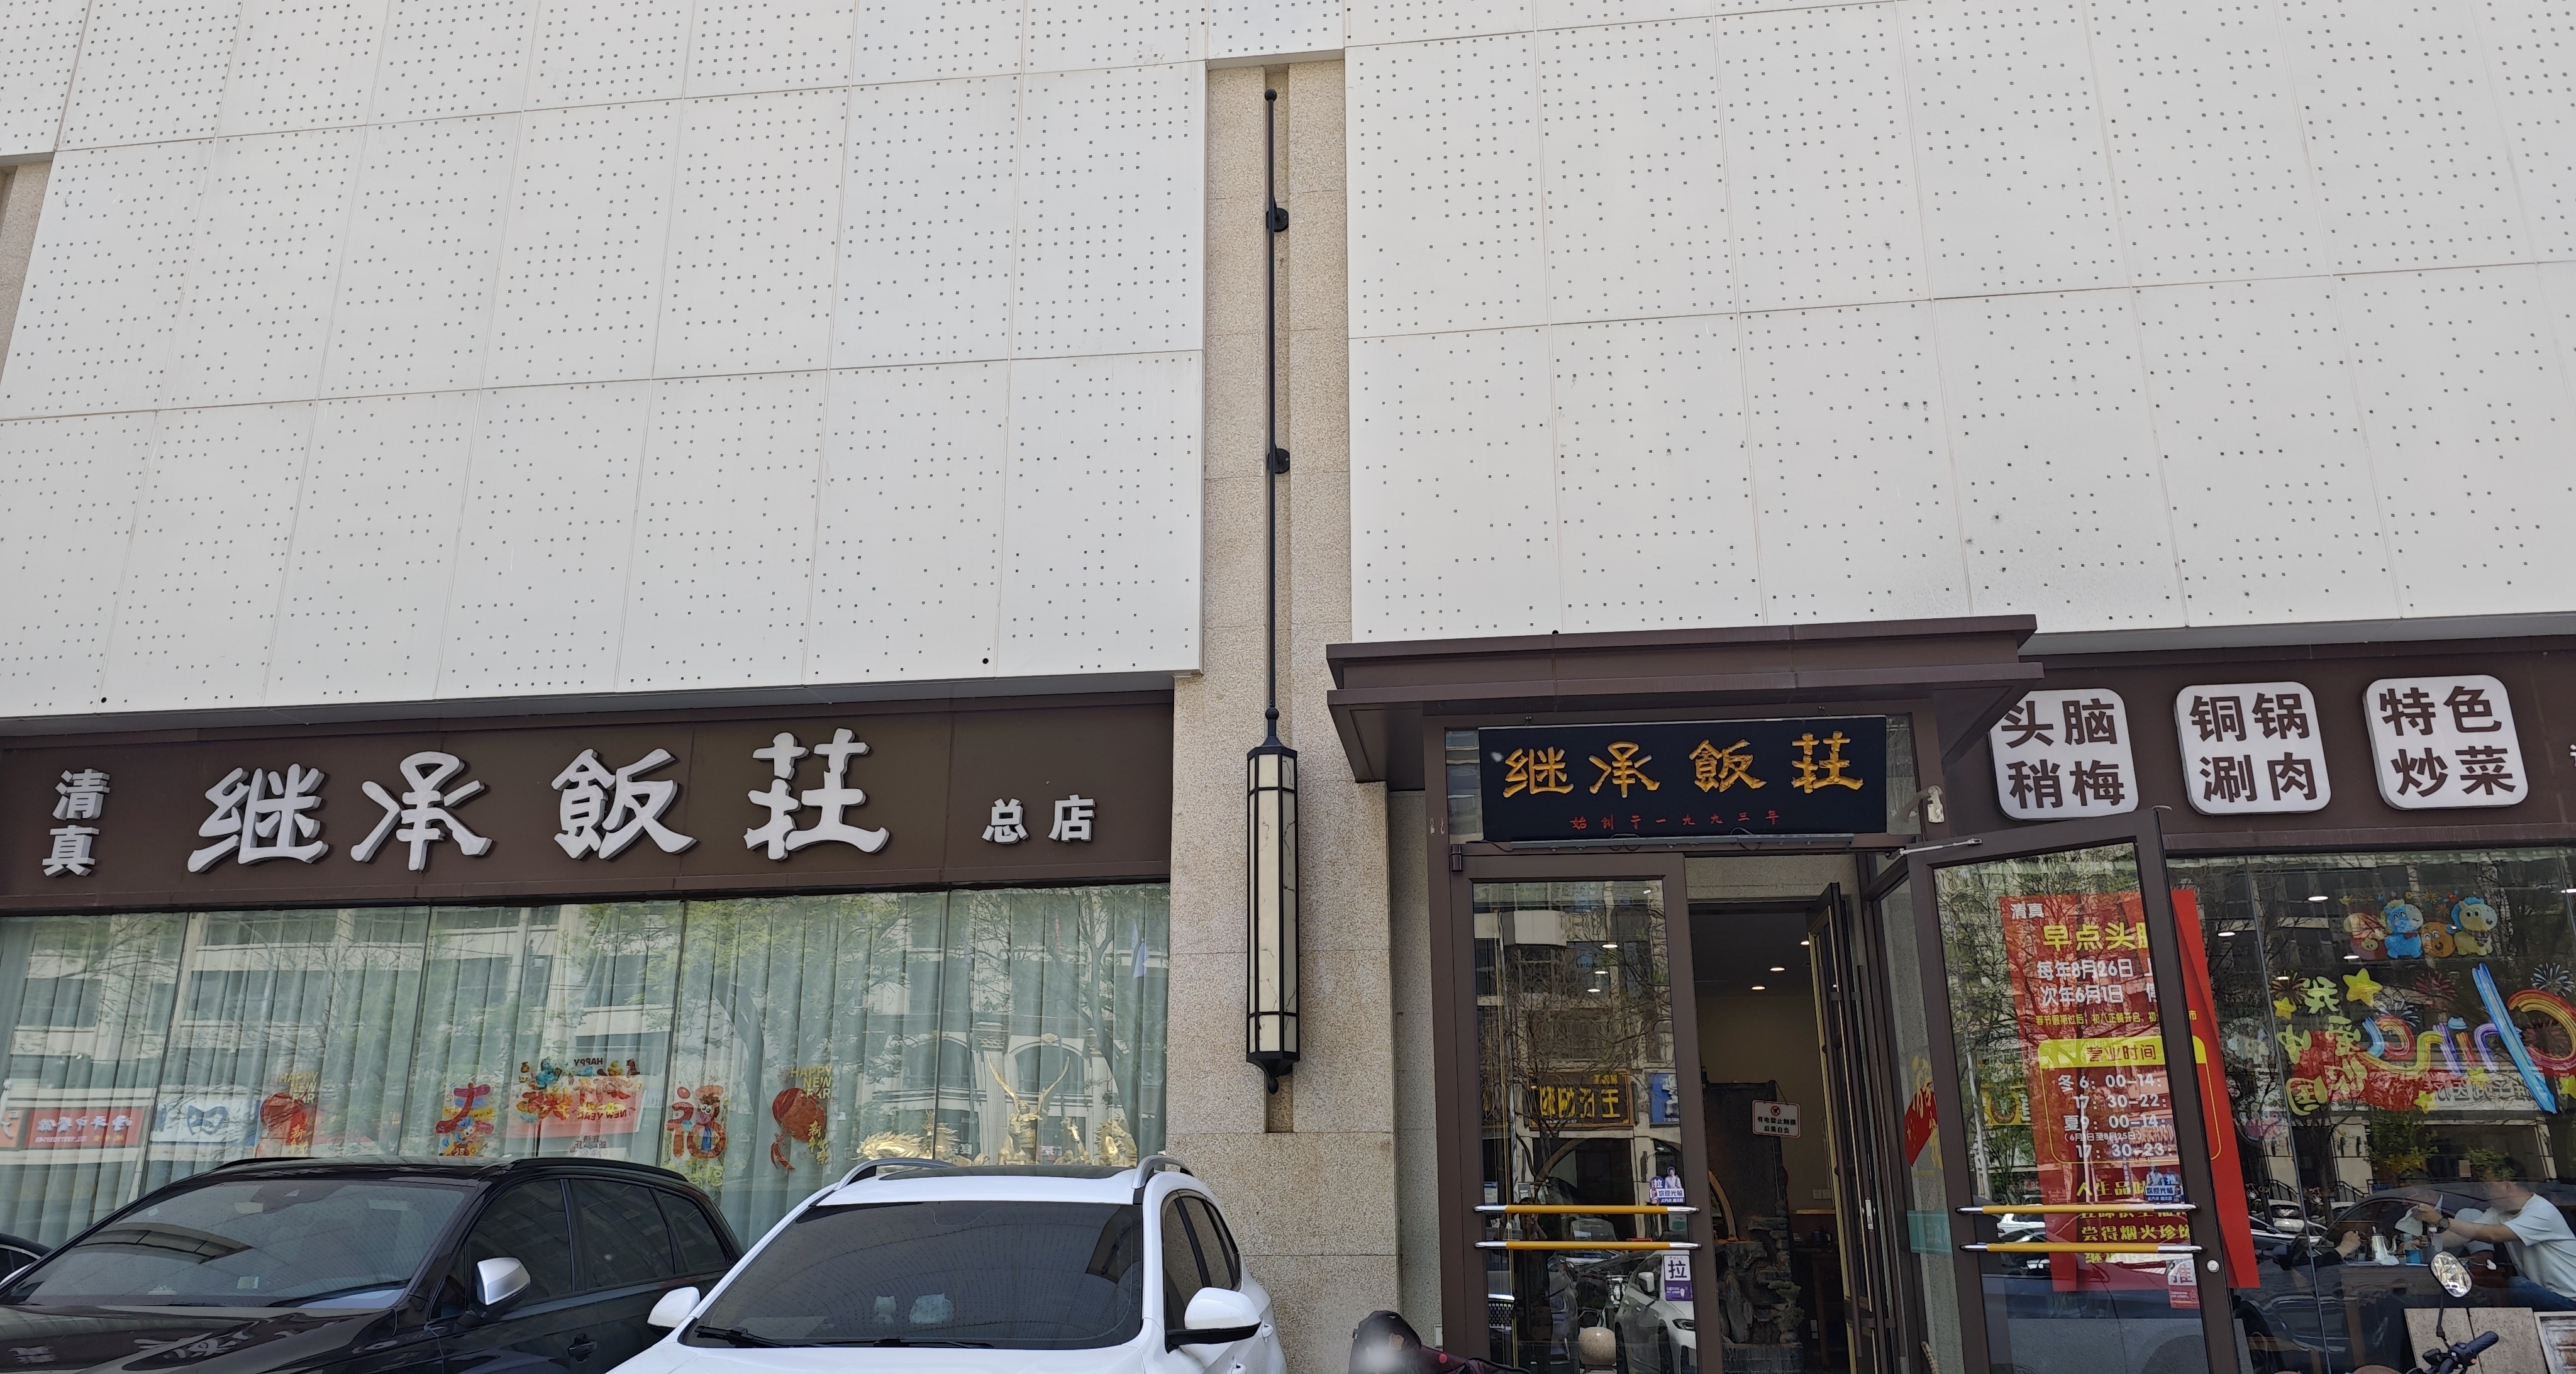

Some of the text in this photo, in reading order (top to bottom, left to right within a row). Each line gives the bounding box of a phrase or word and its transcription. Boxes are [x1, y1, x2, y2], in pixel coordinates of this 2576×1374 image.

[2190, 692, 2311, 743] 铜锅
[2379, 685, 2503, 737] 特色
[2001, 698, 2118, 748] 头脑
[2199, 751, 2318, 804] 涮肉
[2390, 745, 2517, 797] 炒菜
[2006, 759, 2125, 809] 稍梅
[42, 767, 111, 877] 清真
[981, 794, 1096, 843] 总店
[1570, 809, 1779, 830] 始创于一九九三年
[2011, 903, 2045, 919] 清真
[2036, 958, 2133, 980] 每年8月26日
[2041, 984, 2123, 1006] 次年6月1日
[2087, 1044, 2156, 1061] 营业时间
[791, 1067, 833, 1078] HAPPY
[802, 1076, 832, 1088] NEW
[291, 1093, 315, 1104] EAR
[800, 1088, 831, 1099] EAR
[1757, 1116, 1796, 1126] 有电禁止触摸
[1654, 1178, 1663, 1188] 拉
[2167, 1173, 2177, 1185] 推
[1668, 1260, 1687, 1279] 拉
